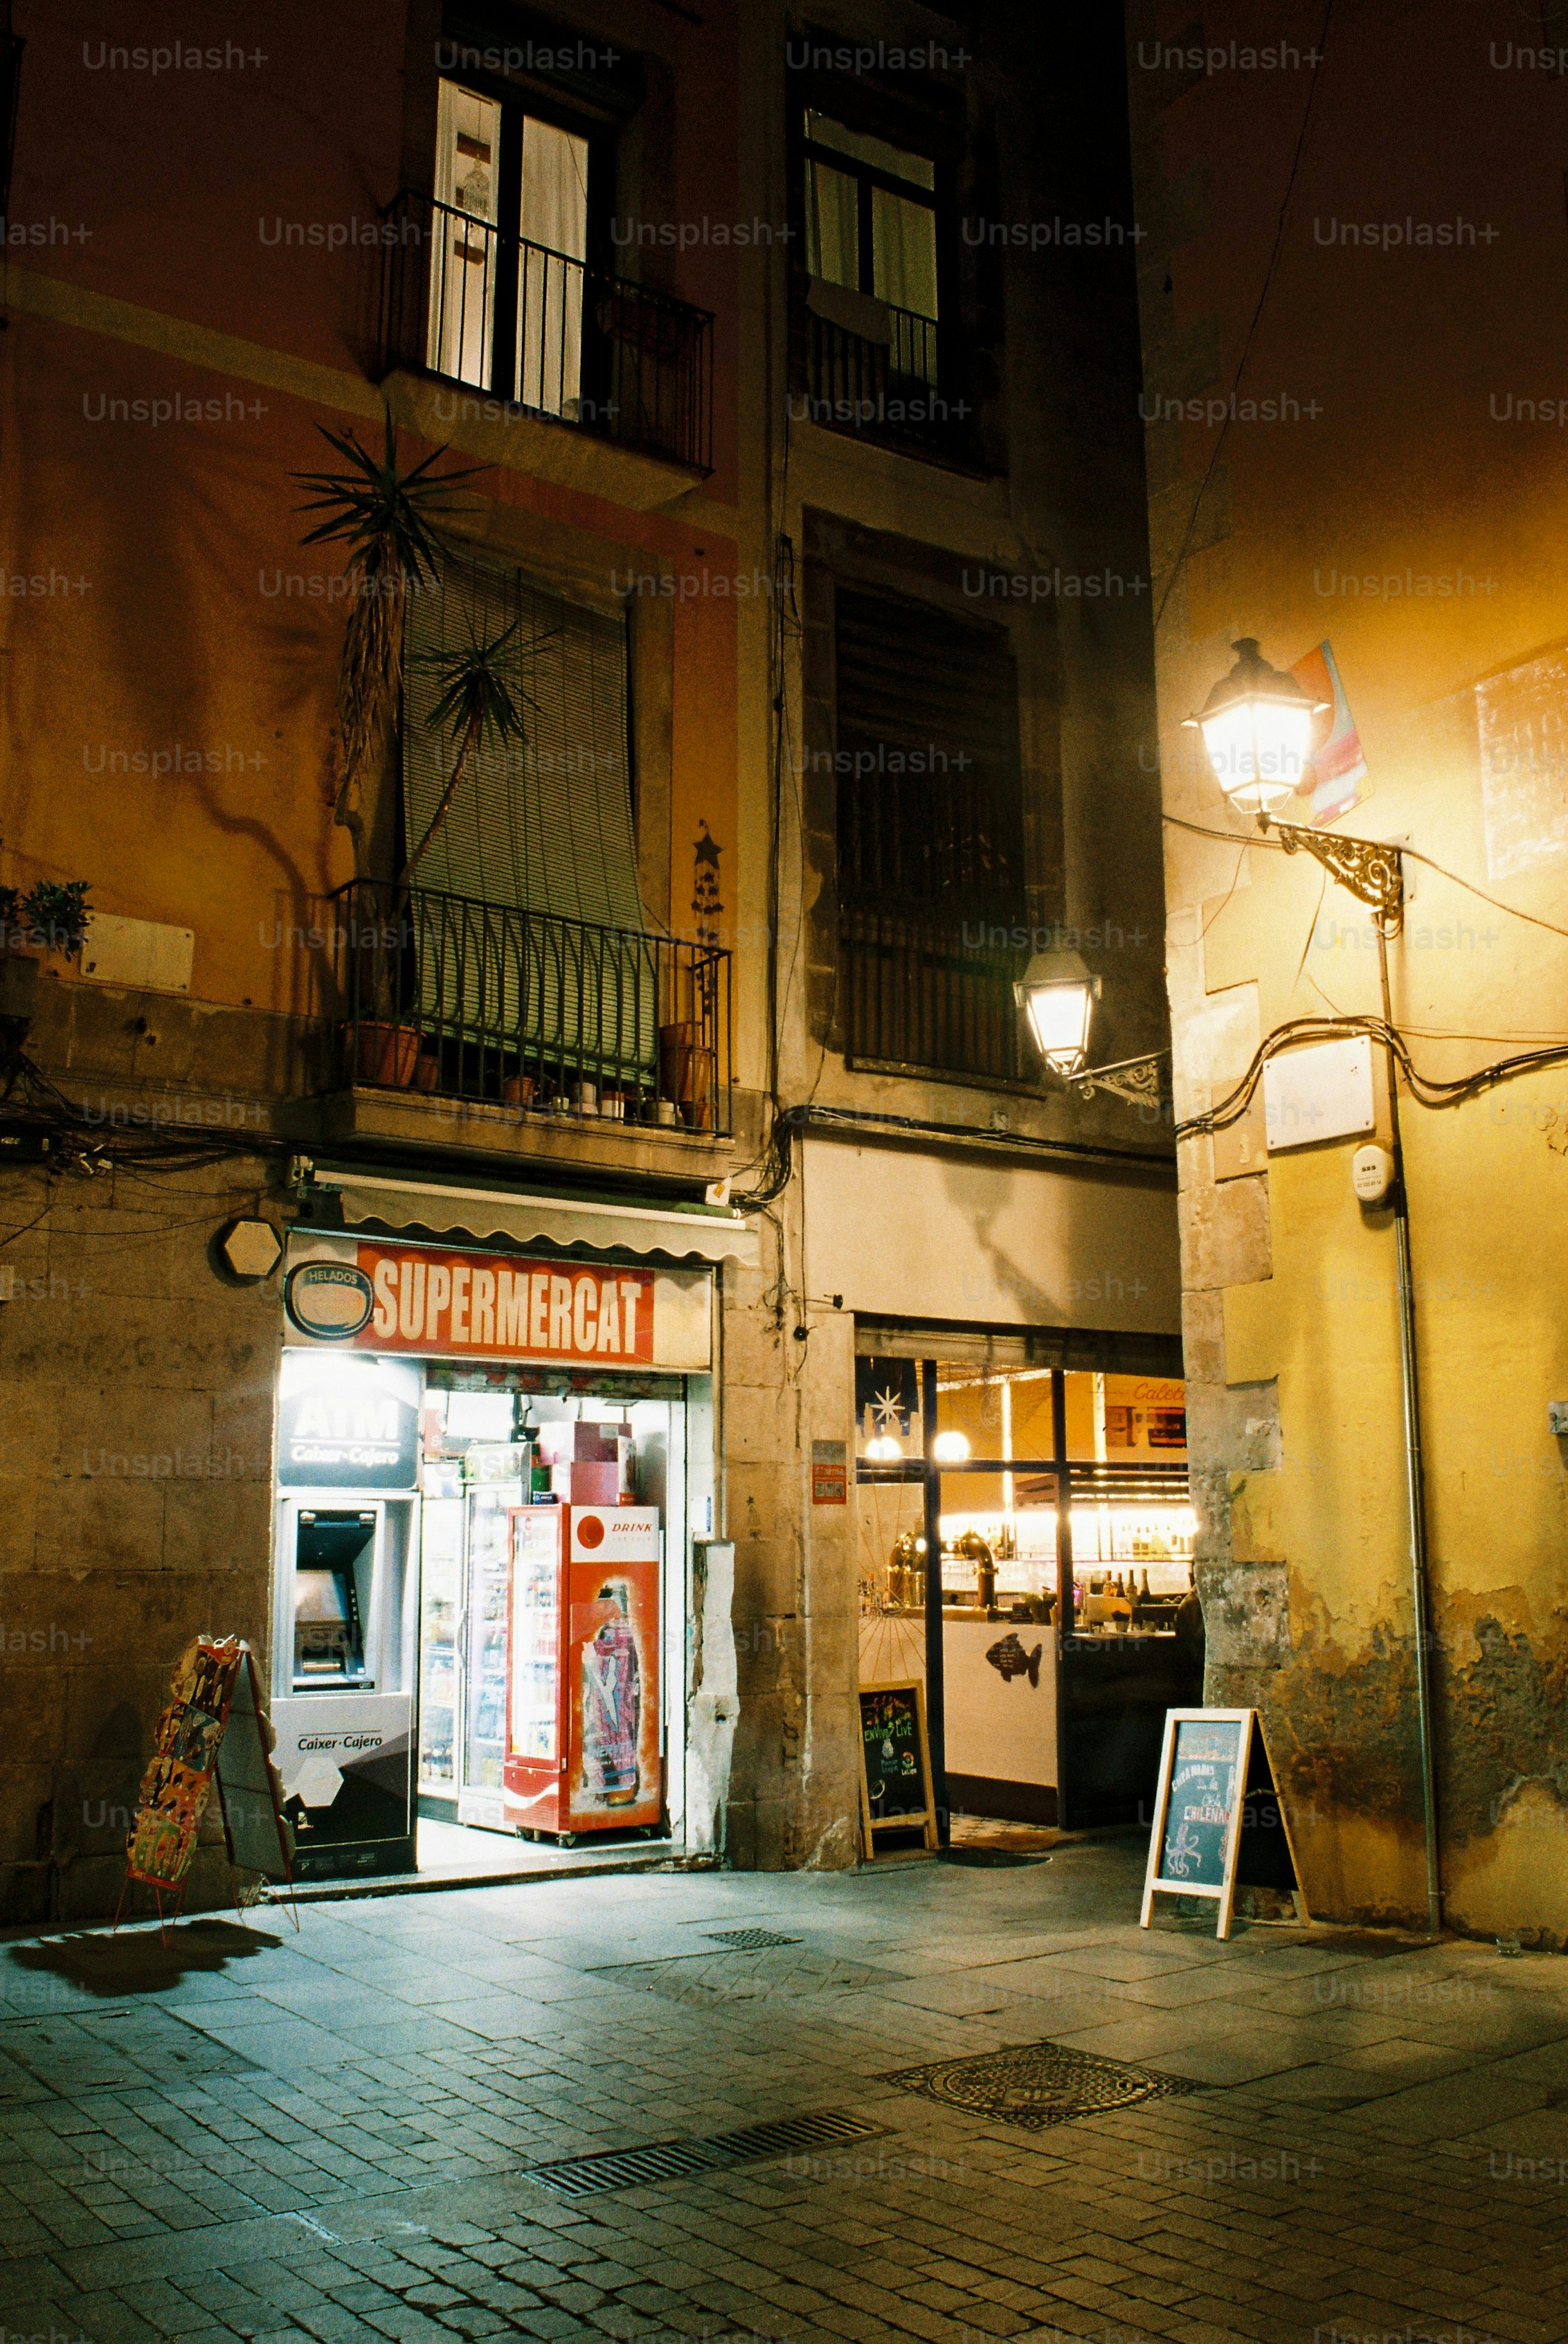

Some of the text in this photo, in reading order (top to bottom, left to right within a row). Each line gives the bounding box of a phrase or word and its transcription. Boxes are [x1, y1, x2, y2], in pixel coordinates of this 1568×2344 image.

[309, 1270, 359, 1286] HELADOS
[372, 1257, 642, 1354] SUPERMERCAT
[295, 1397, 399, 1439] ATM
[612, 1522, 654, 1533] DRINK
